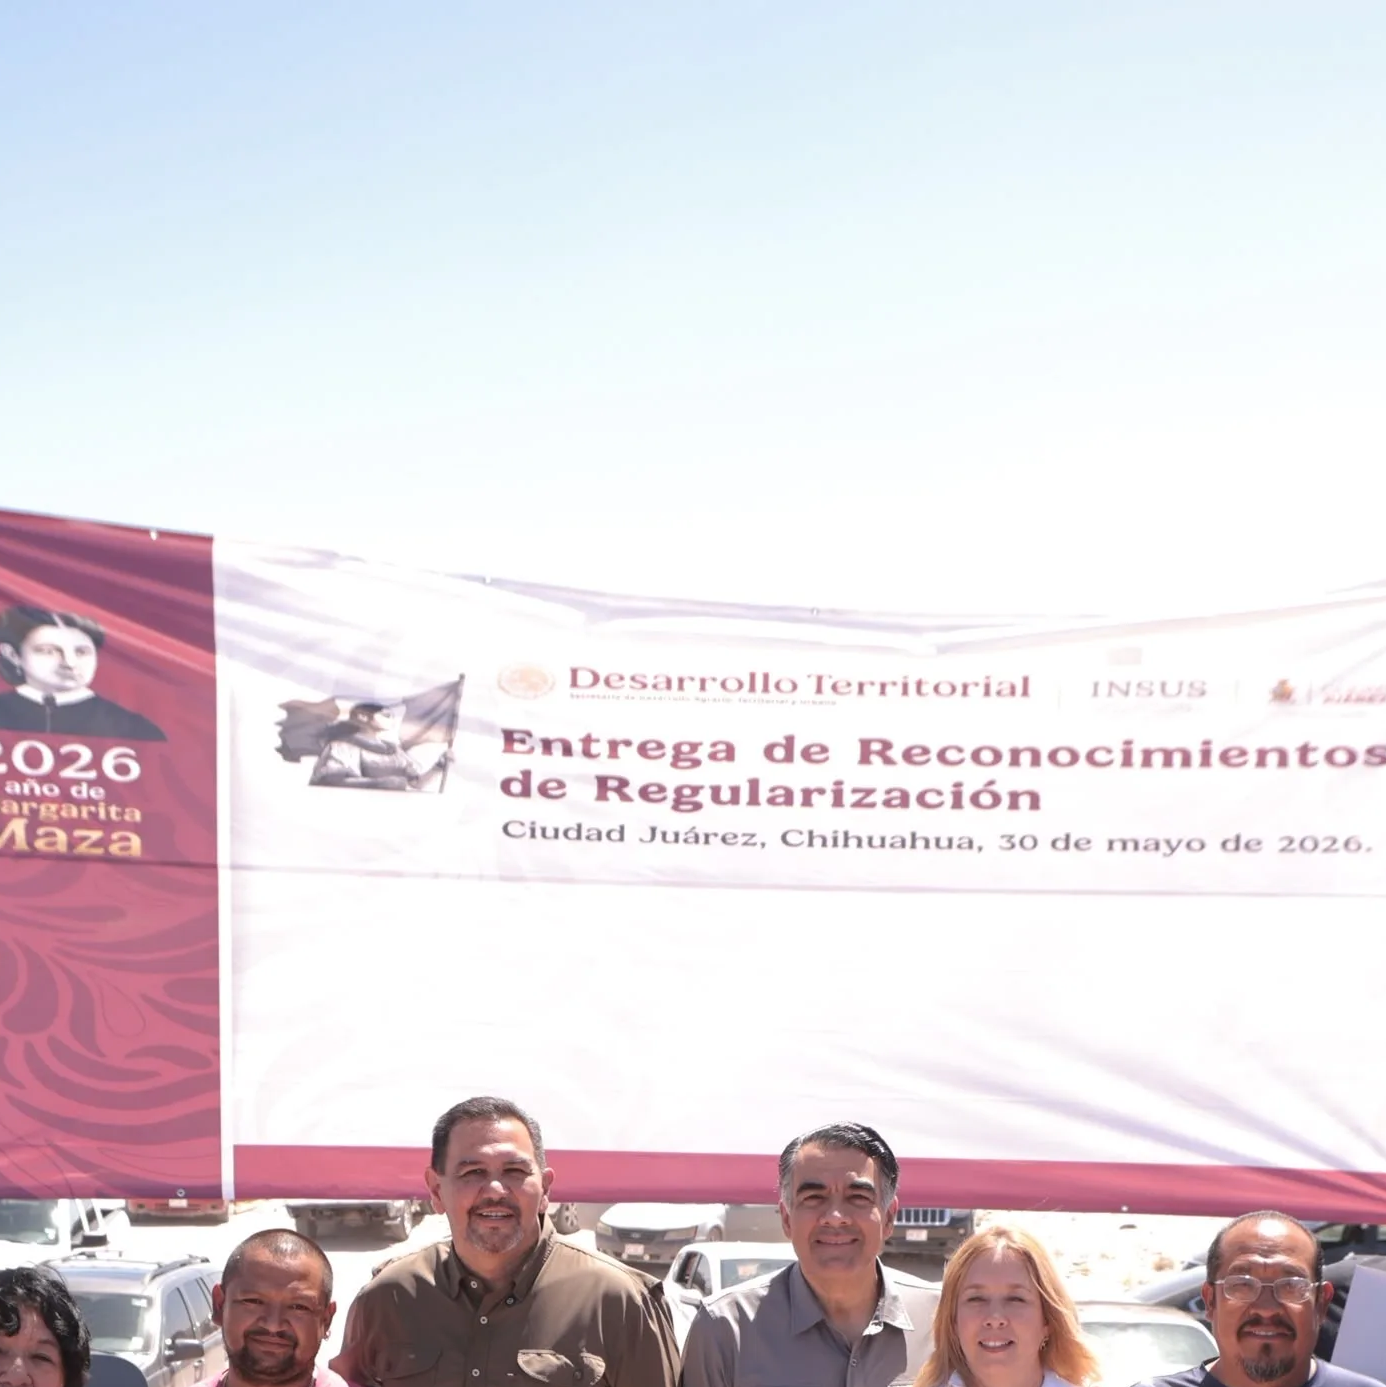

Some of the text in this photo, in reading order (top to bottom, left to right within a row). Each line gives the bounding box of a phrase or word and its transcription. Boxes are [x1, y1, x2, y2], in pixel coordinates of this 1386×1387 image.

[570, 668, 1030, 698] Desarrollo Territorial
[1092, 681, 1206, 697] INSUS
[501, 728, 735, 770] Entrega
[764, 735, 829, 764] de
[4, 777, 106, 801] año de
[500, 770, 1040, 813] de Regularización
[502, 821, 1371, 856] Ciudad Juárez, Chihuahua, 30 de mayo de 2026.
